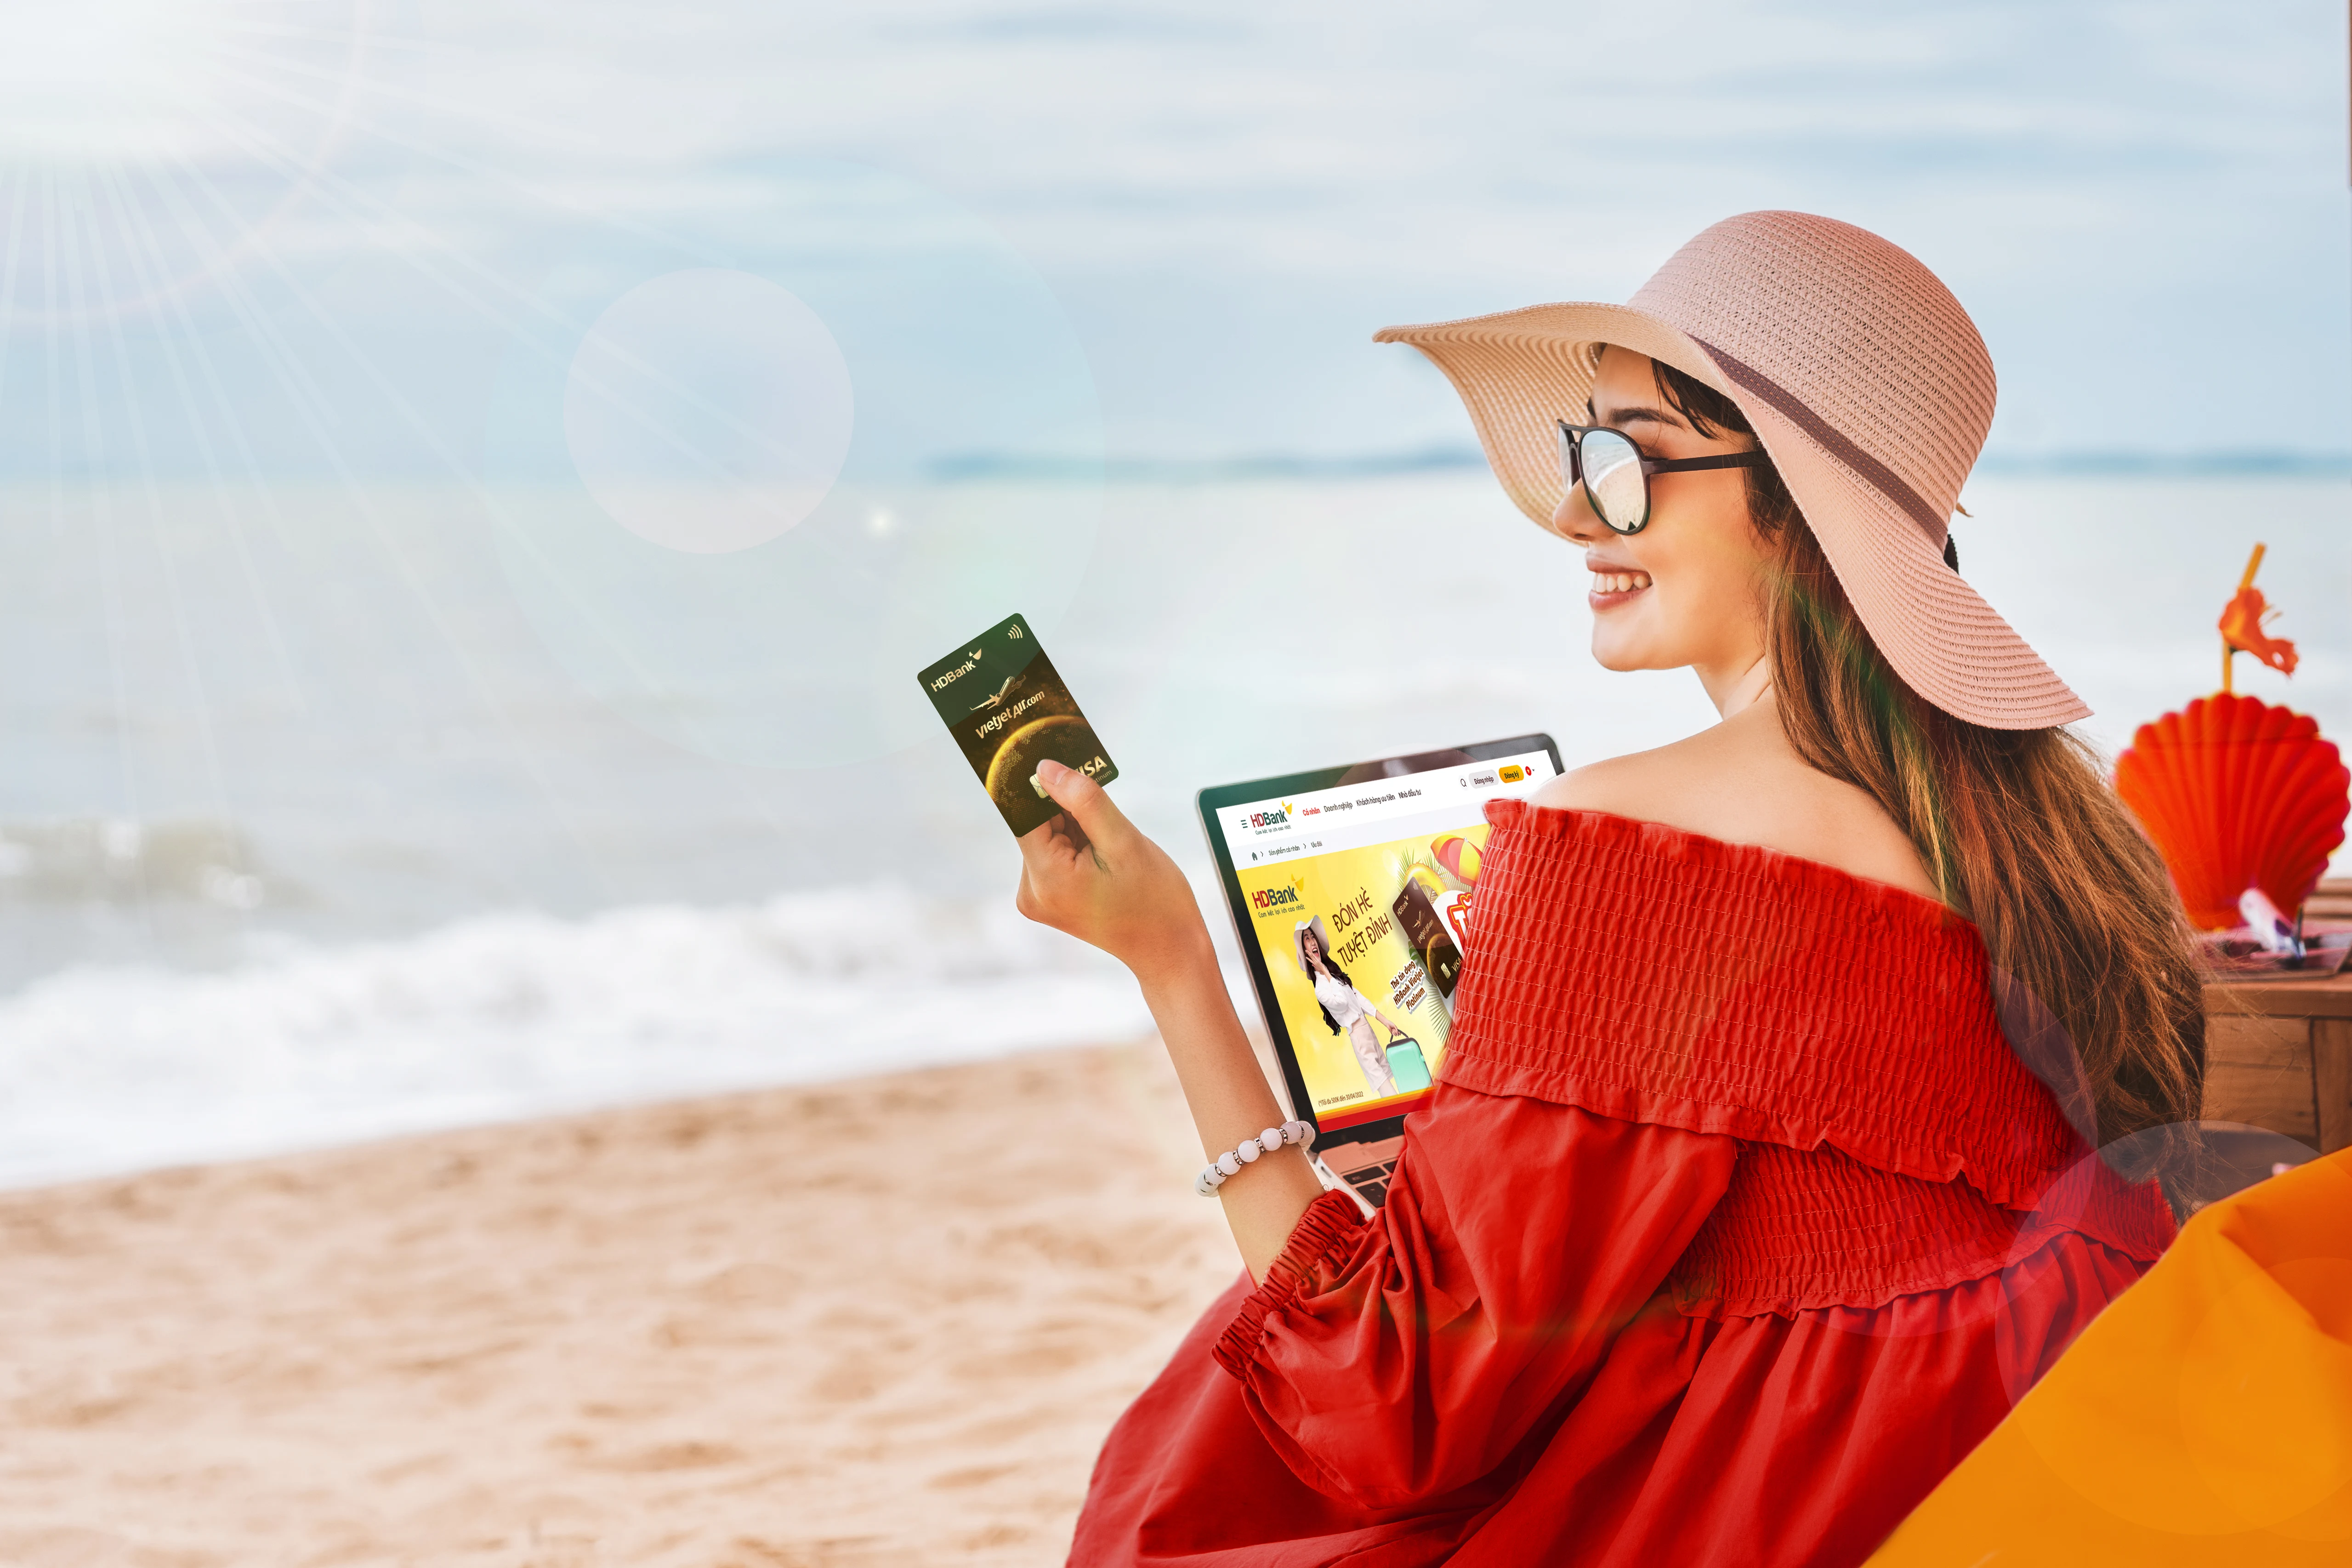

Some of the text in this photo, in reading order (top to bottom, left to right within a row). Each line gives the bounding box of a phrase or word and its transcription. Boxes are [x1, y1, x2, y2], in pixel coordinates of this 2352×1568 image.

[931, 660, 976, 692] HDBank
[1075, 756, 1108, 778] ISA
[1094, 770, 1112, 783] tinum
[1356, 797, 1370, 806] Khách
[1398, 790, 1408, 799] Nhà
[1408, 789, 1416, 797] đầu
[1302, 808, 1309, 816] Cá
[1324, 801, 1353, 812] Doanh nghiệp
[1250, 809, 1288, 828] HDBank
[1251, 885, 1299, 909] HDBank
[1332, 886, 1373, 933] ĐÓN HÈ
[1397, 900, 1409, 917] HDBank
[1337, 913, 1392, 966] TUYỆT ĐỈNH
[1451, 957, 1462, 972] VISA
[1391, 977, 1399, 989] Thẻ
[1404, 961, 1416, 974] dụng
[1393, 968, 1424, 1005] HDBank Vietjet
[1406, 988, 1425, 1010] Platinum
[1346, 1091, 1364, 1100] 30/04/2022
